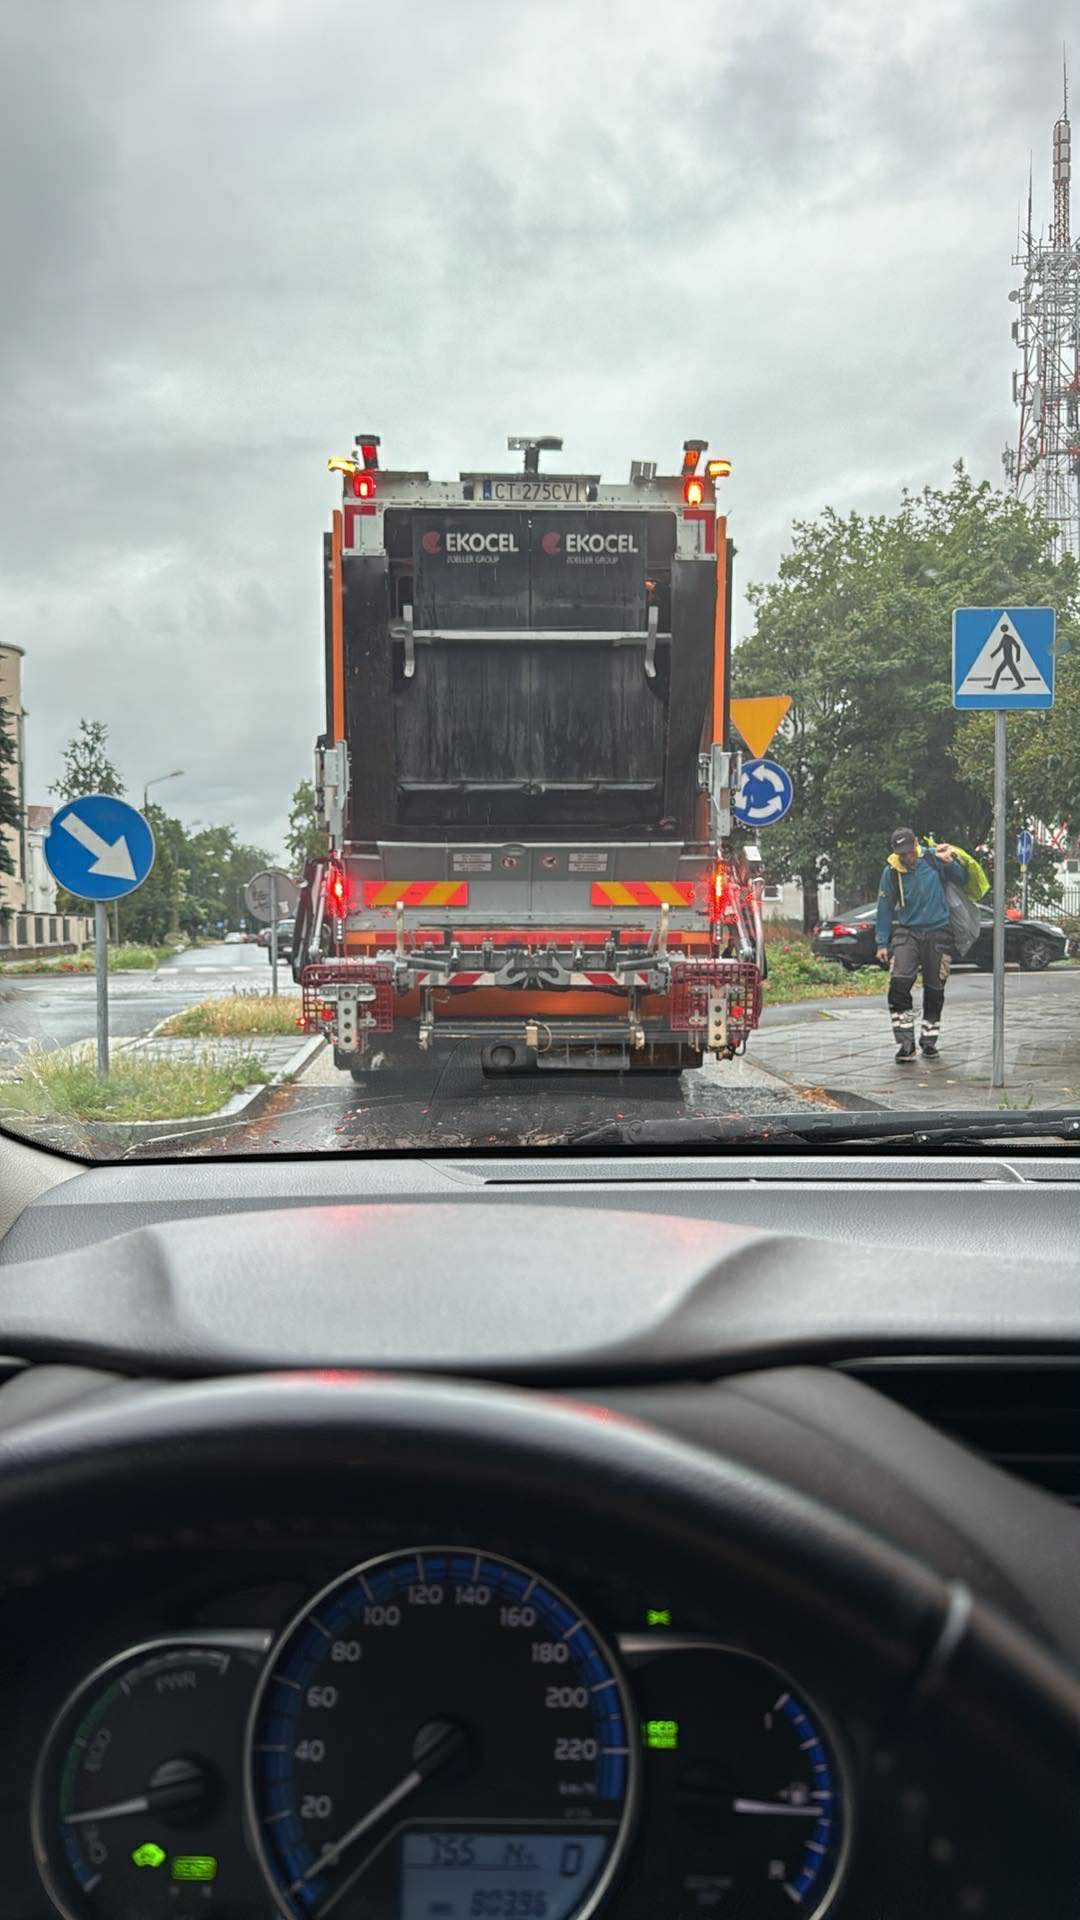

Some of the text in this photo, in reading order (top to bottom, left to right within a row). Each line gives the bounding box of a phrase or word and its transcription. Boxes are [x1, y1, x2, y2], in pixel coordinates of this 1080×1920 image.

[495, 483, 573, 501] CT 275CV
[446, 533, 519, 553] EKOCEL
[566, 533, 639, 553] EKOCEL
[477, 555, 499, 564] GROUP
[595, 555, 619, 565] GROUP
[408, 1585, 443, 1606] 120
[455, 1585, 489, 1606] 140
[363, 1606, 400, 1627] 100
[500, 1606, 537, 1627] 160
[331, 1642, 360, 1663] 80
[531, 1642, 569, 1663] 180
[308, 1687, 338, 1708] 60
[545, 1687, 588, 1708] 200
[295, 1739, 325, 1761] 40
[555, 1739, 598, 1761] 220
[301, 1796, 330, 1818] 20
